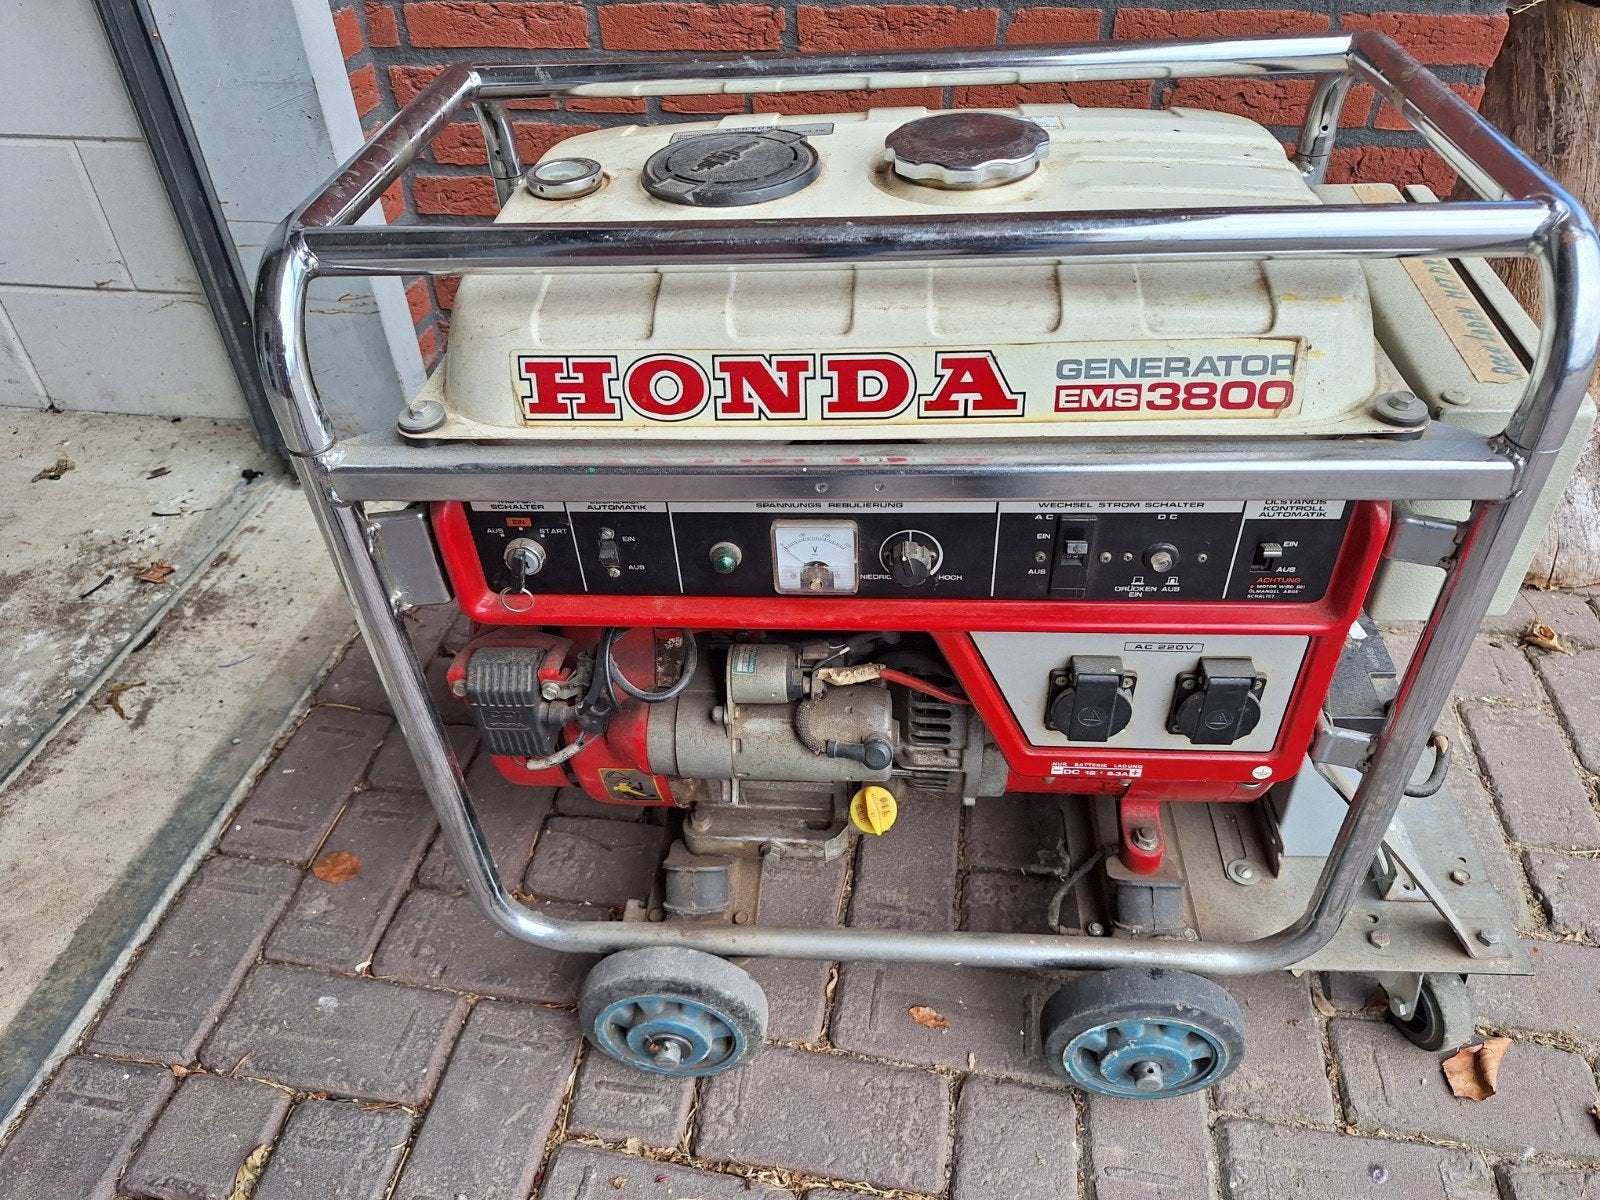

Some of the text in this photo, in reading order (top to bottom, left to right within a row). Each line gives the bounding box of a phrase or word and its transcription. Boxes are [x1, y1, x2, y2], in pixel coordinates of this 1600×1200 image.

[1056, 354, 1296, 380] GENERATOR
[518, 350, 1027, 422] HONDA
[1057, 380, 1295, 411] EMS 3800
[1114, 584, 1157, 592] DRÜCKEN
